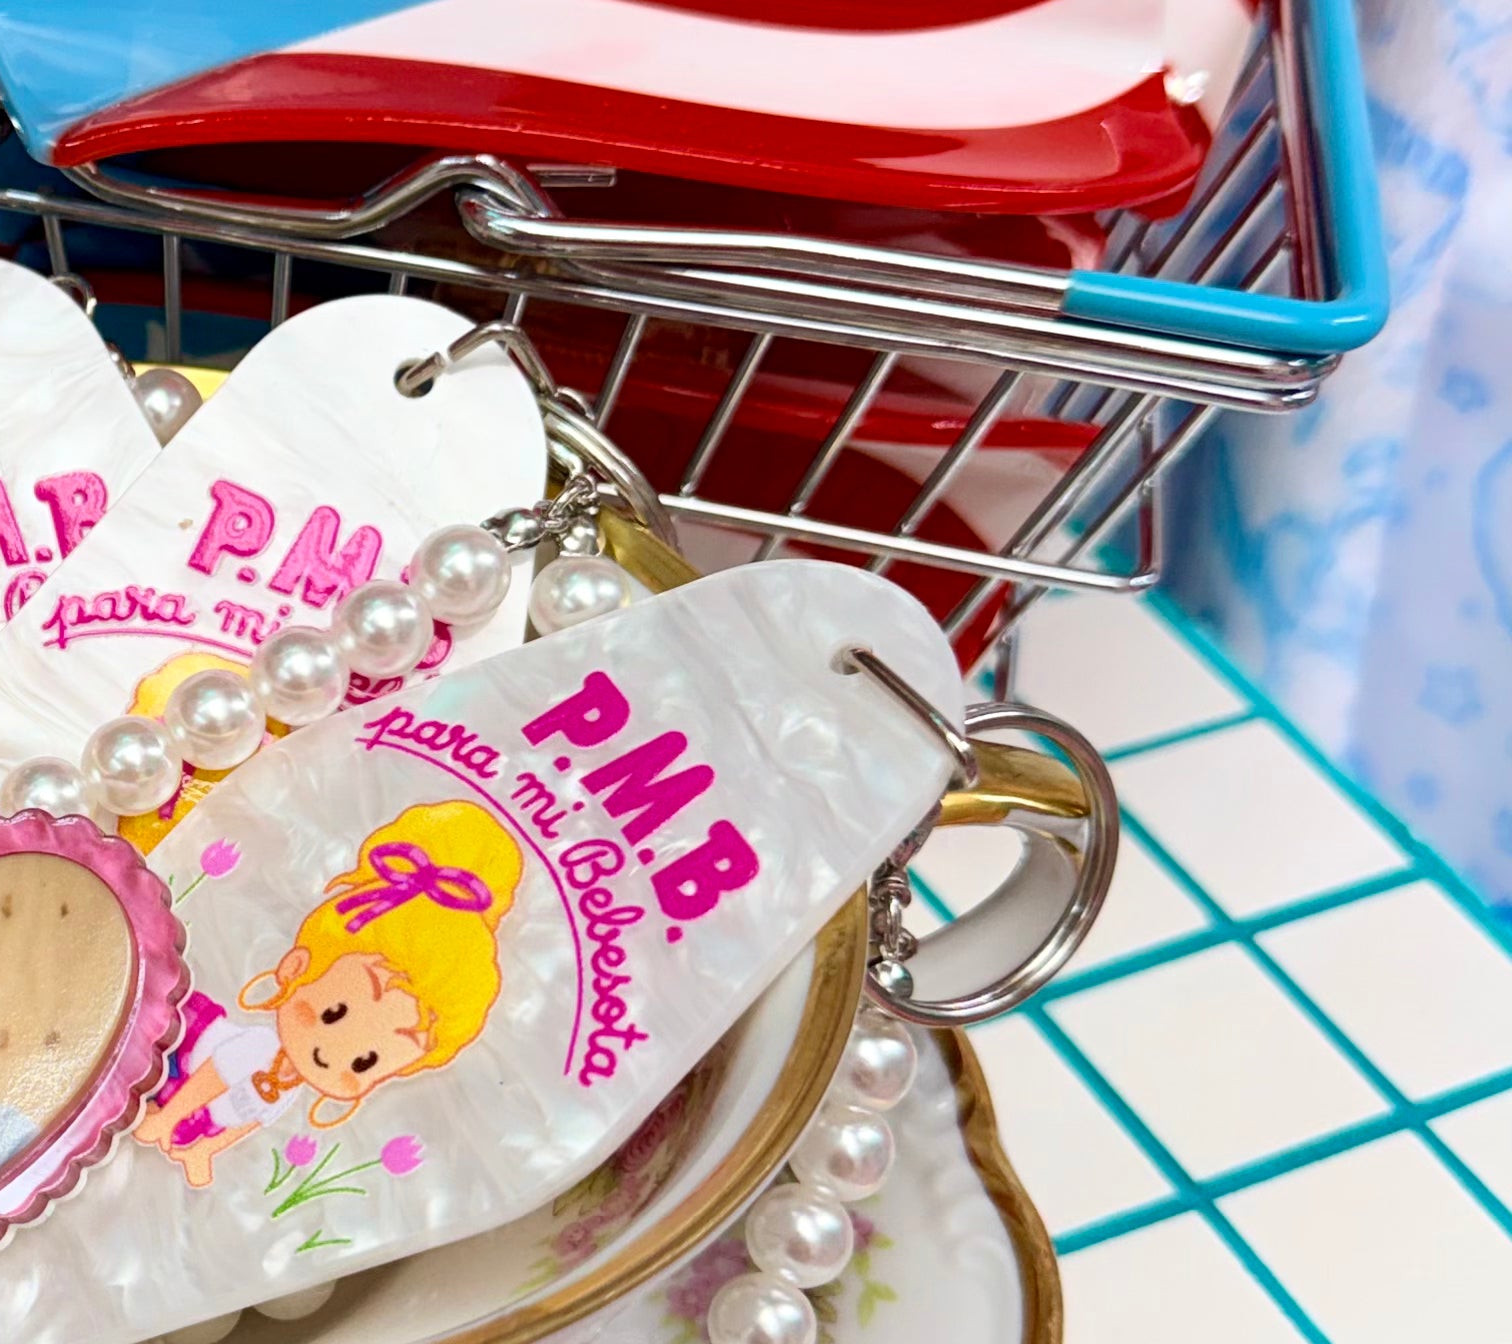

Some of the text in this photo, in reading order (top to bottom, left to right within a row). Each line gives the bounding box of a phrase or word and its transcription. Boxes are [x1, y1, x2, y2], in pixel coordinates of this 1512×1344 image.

[40, 584, 196, 651] para
[362, 706, 504, 780] para
[510, 771, 587, 840] mi
[557, 837, 650, 1088] Bebesota
[520, 669, 761, 945] P.M.B.
